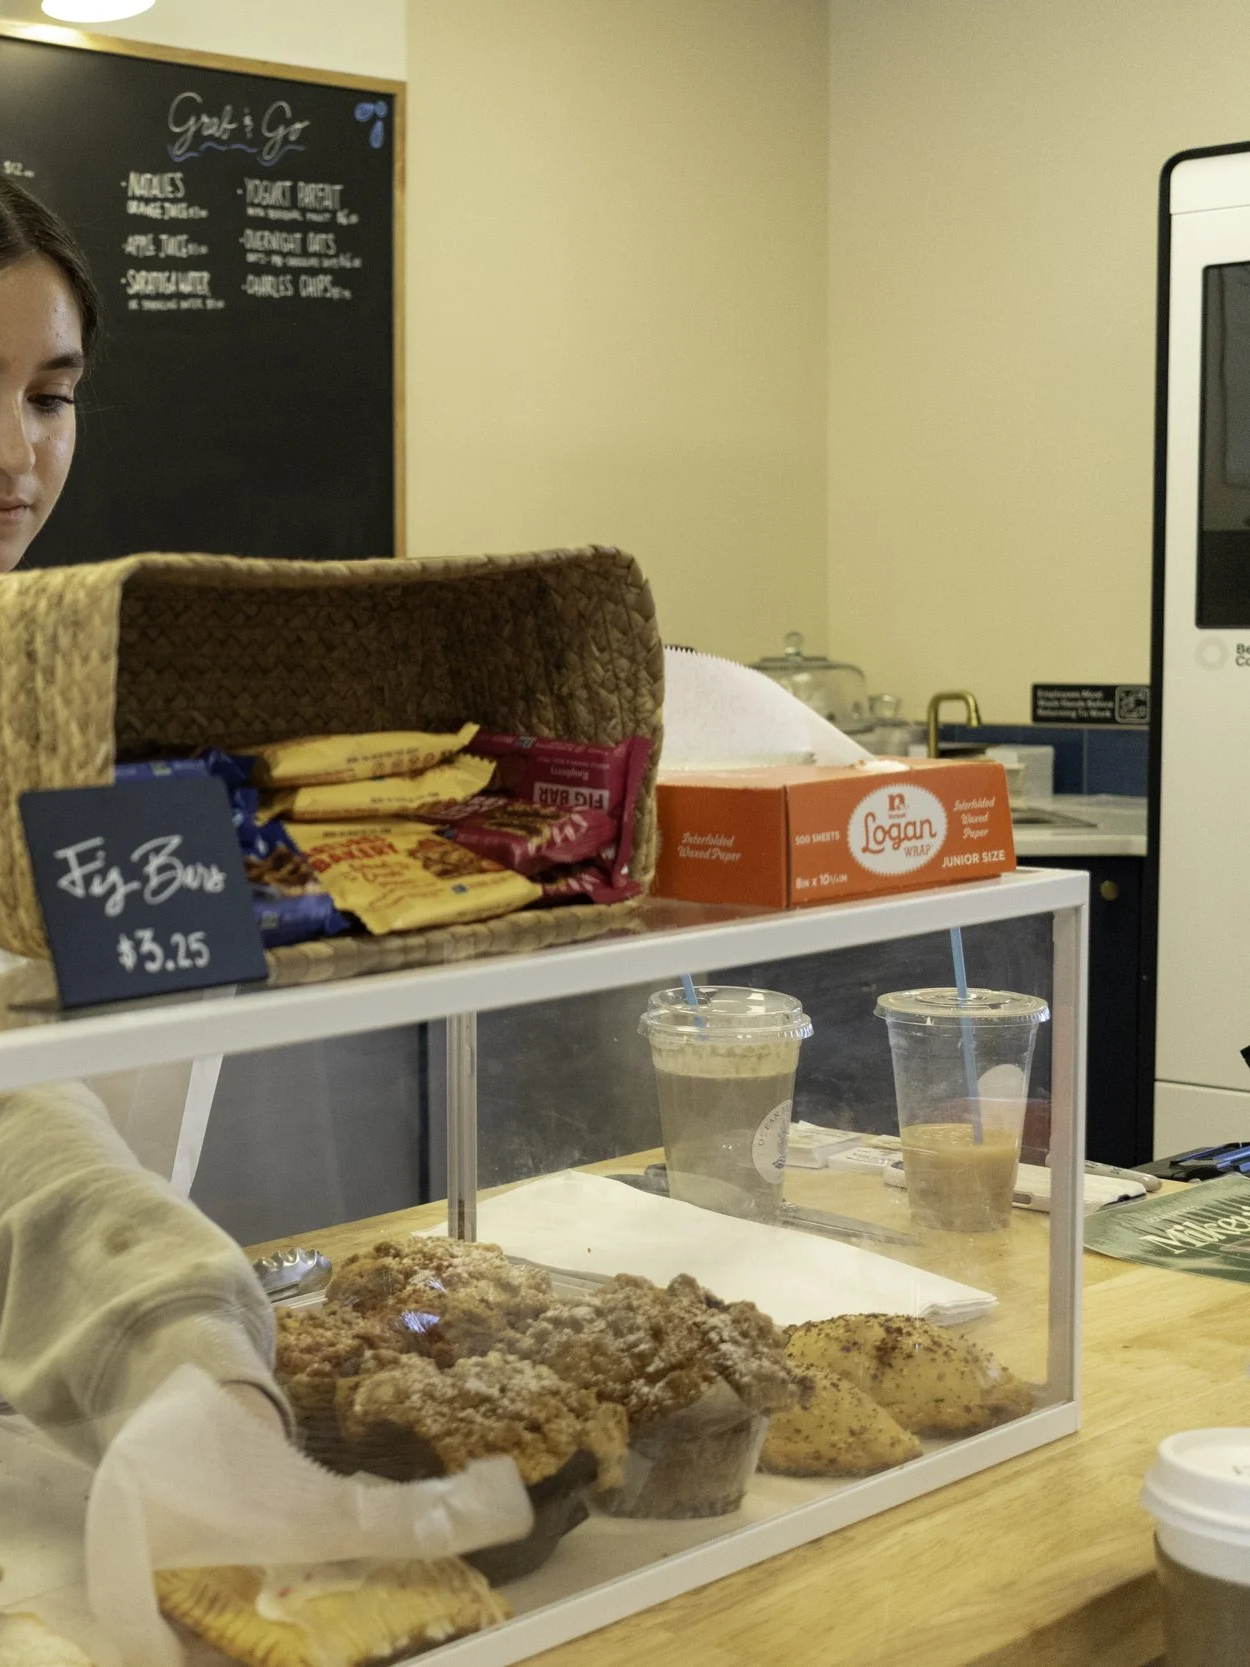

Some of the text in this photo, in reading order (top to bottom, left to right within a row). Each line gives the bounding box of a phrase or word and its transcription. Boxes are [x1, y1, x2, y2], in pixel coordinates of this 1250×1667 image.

[167, 91, 238, 155] Grab
[261, 100, 311, 160] Go
[537, 786, 605, 810] FIG BAR
[811, 830, 840, 844] SHEETS
[861, 811, 937, 854] Logan
[903, 844, 931, 858] WRAP
[941, 849, 1006, 868] JUNIOR SIZE
[53, 834, 227, 918] Fig Bars
[116, 927, 211, 973] $3.25
